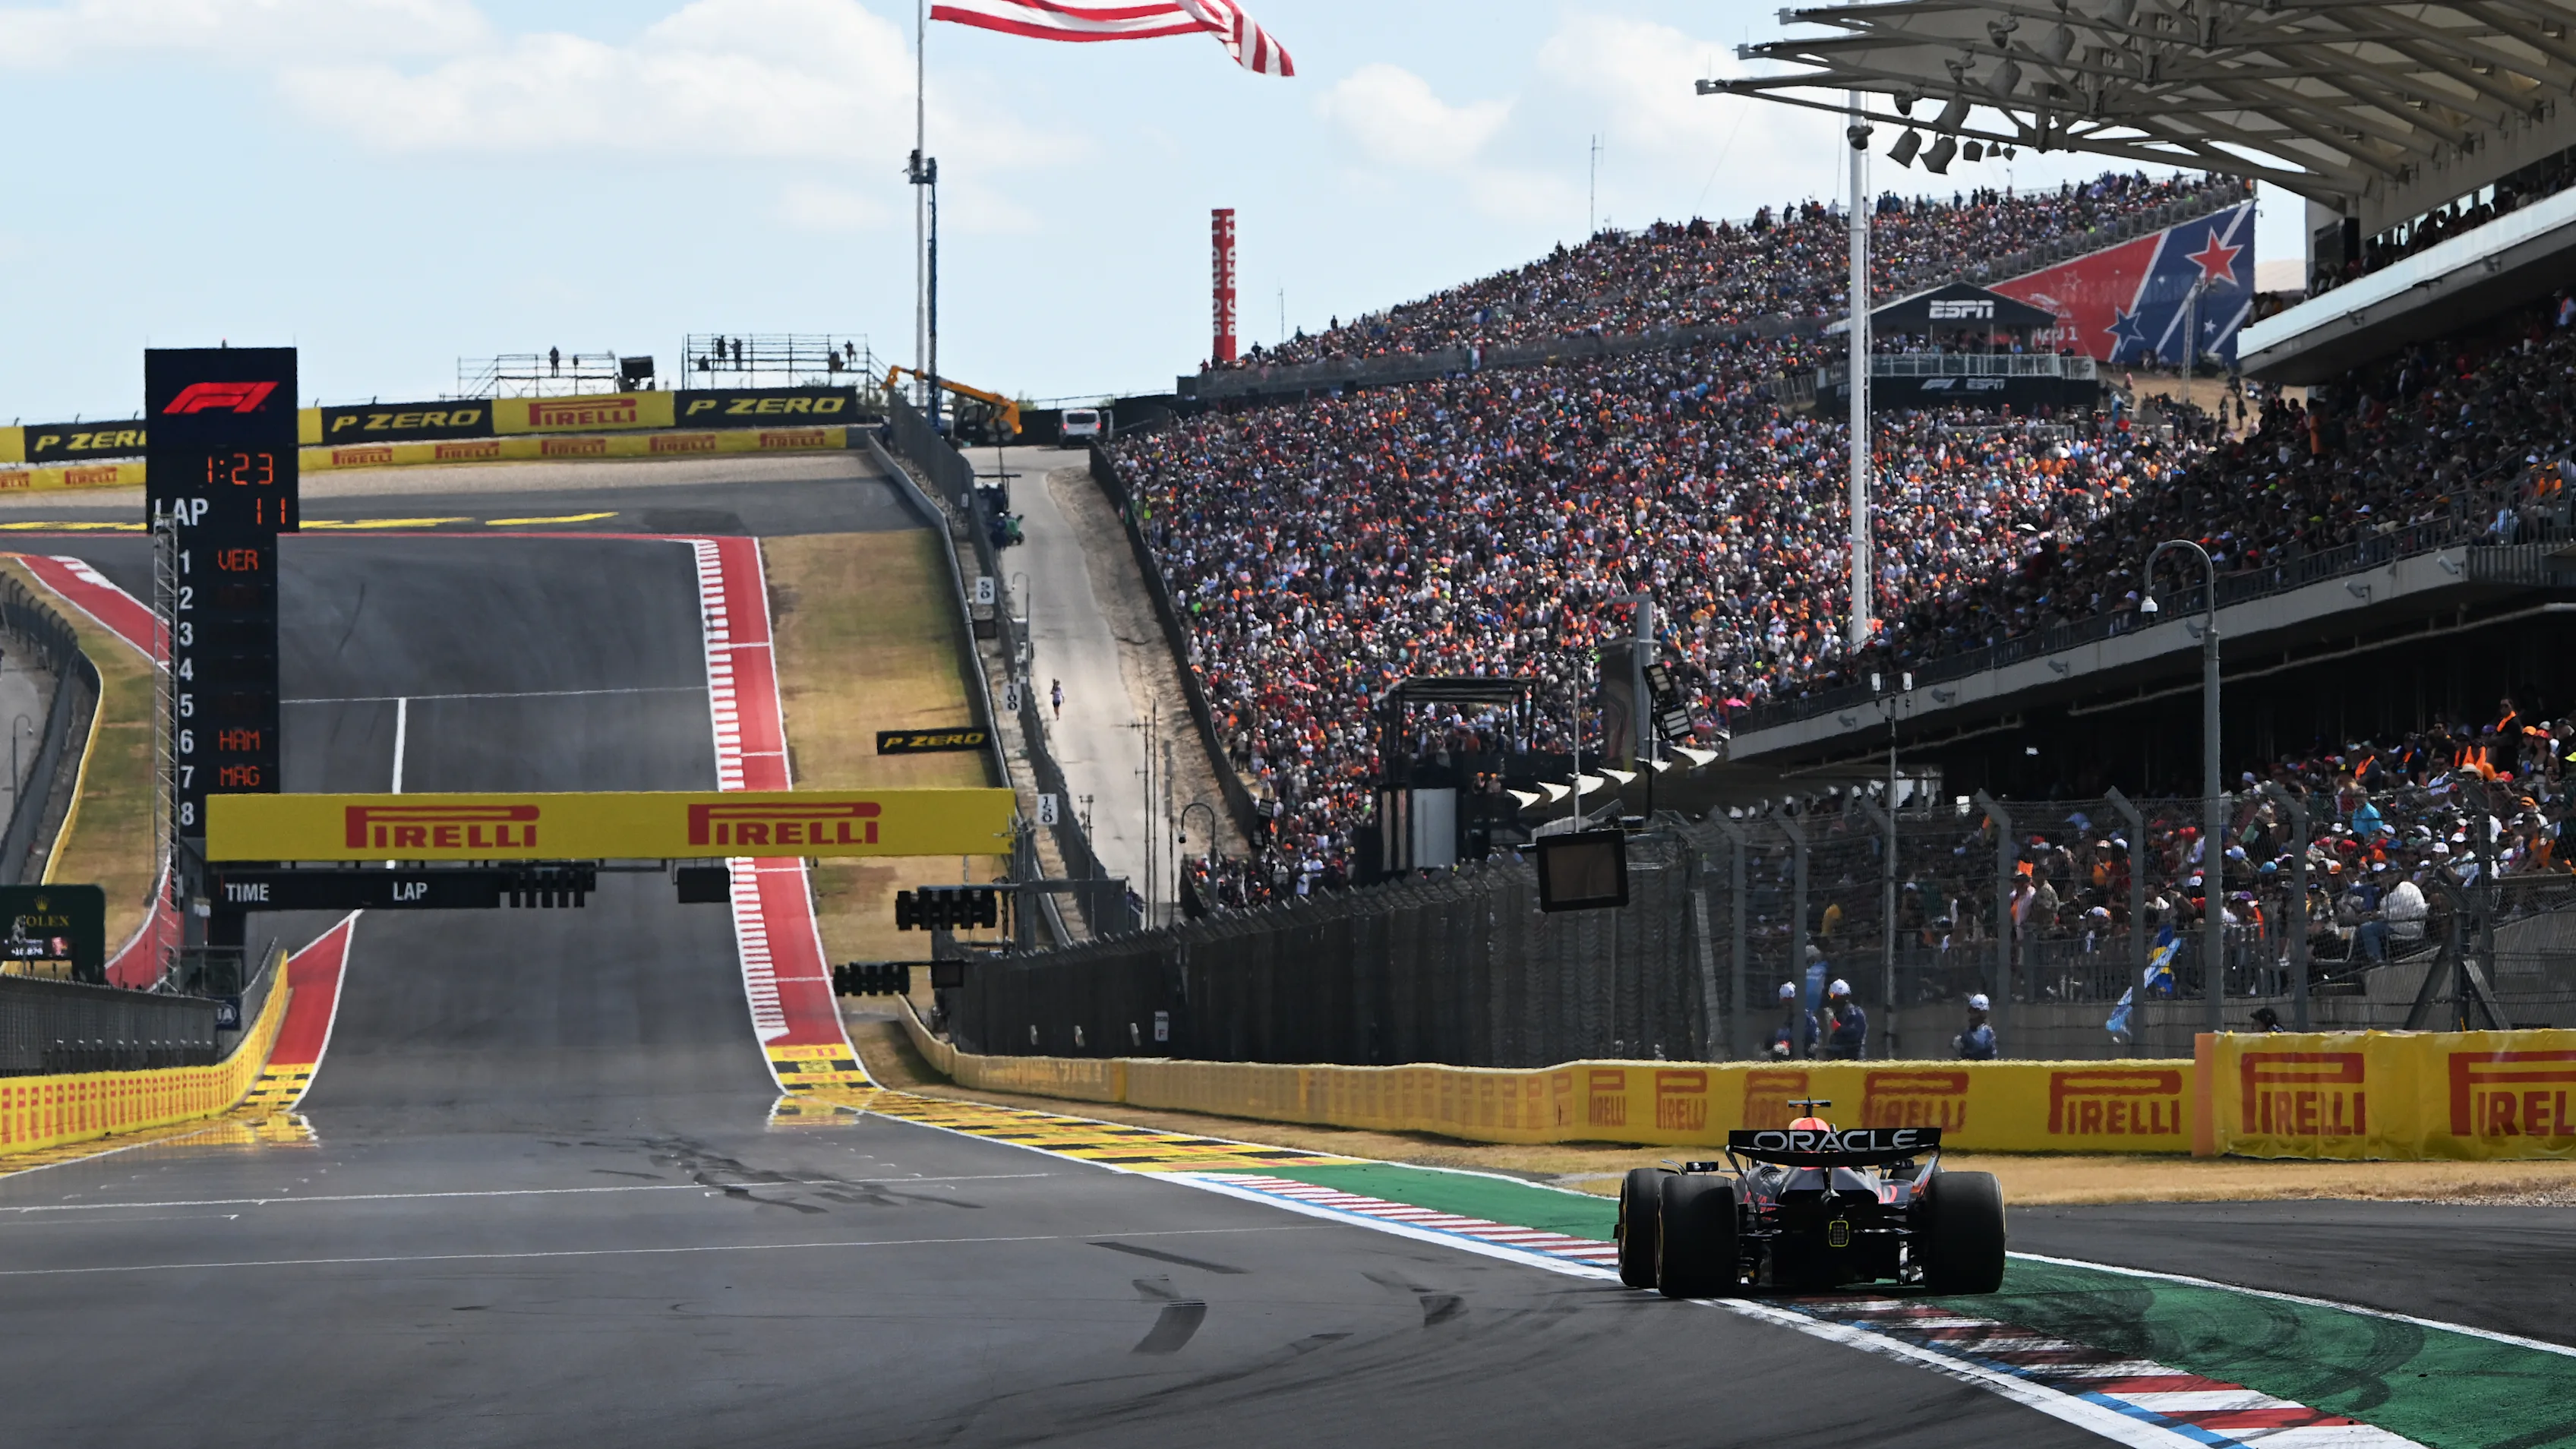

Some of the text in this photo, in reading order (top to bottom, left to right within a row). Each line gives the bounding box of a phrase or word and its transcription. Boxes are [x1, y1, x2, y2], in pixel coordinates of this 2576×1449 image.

[1929, 299, 1994, 319] ESPN
[163, 381, 279, 413] F1
[686, 396, 846, 415] P ZERO
[330, 409, 481, 432] P ZERO
[529, 398, 636, 426] PIRELLI
[34, 434, 61, 453] P
[207, 453, 273, 486] 1:23
[155, 497, 209, 526] LAP
[179, 548, 258, 574] 1 VER
[179, 586, 192, 609] 2
[179, 621, 193, 646] 3
[179, 658, 193, 680] 4
[180, 693, 194, 717] 5
[180, 729, 260, 753] 6 HAM
[883, 733, 985, 749] P ZERO
[180, 766, 260, 788] 7 MAG
[181, 802, 194, 826] 8
[688, 802, 882, 845] PIRELLI
[346, 806, 540, 848] PIRELLI
[225, 882, 428, 902] TIME LAP
[15, 915, 70, 927] OLEX
[1655, 1069, 1707, 1131] PIRELLI
[2047, 1070, 2183, 1135] PIRELLI
[2240, 1052, 2367, 1136] PIRELLI
[2448, 1050, 2576, 1136] PIREL
[1753, 1129, 1918, 1151] ORACLE
